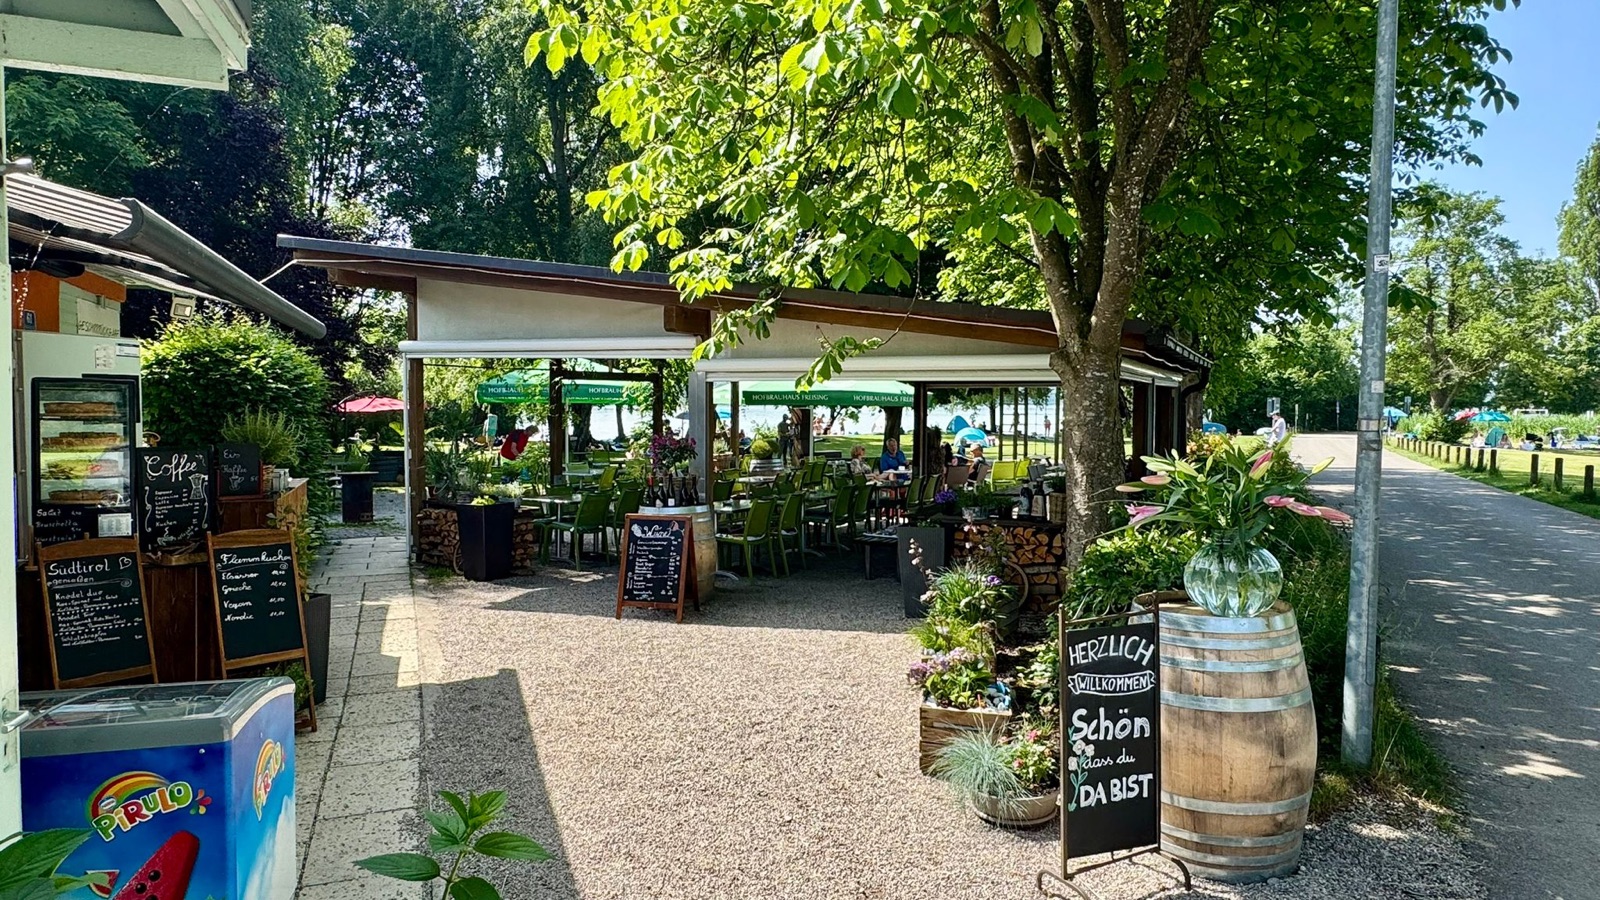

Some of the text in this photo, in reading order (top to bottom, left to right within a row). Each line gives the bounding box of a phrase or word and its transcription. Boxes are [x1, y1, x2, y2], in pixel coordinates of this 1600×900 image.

[145, 453, 197, 482] Coffee
[48, 558, 111, 576] Südtirol
[220, 548, 292, 565] Flammkuchen
[1068, 634, 1155, 666] HERZLICH
[1078, 675, 1147, 691] WILLKOMMEN
[1071, 707, 1151, 741] Schön
[1082, 747, 1136, 769] dass du
[1080, 773, 1153, 808] DA BIST
